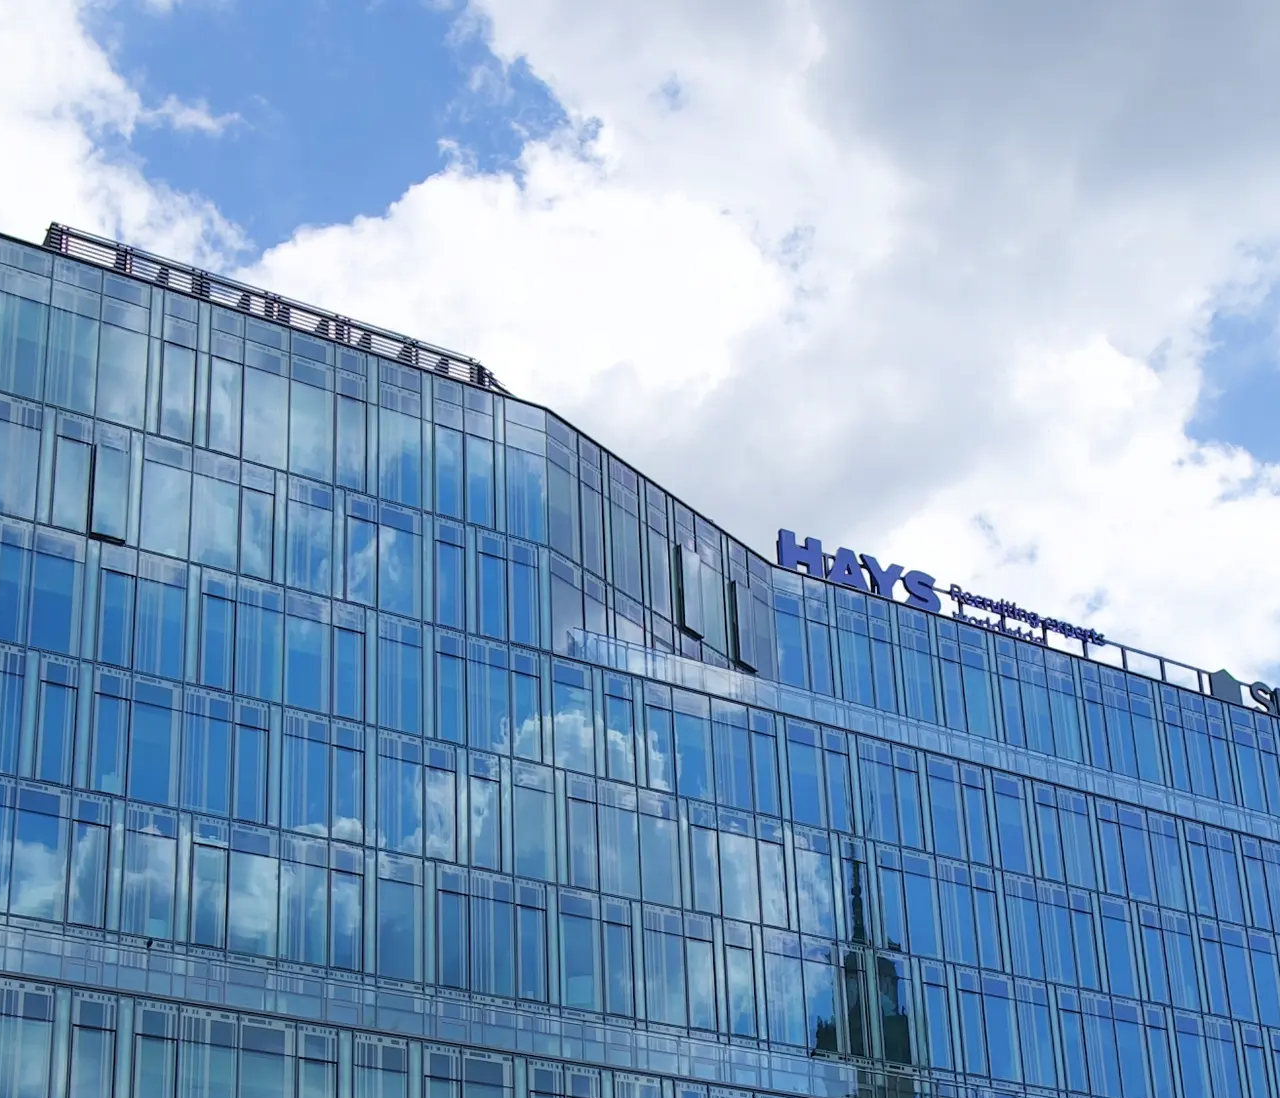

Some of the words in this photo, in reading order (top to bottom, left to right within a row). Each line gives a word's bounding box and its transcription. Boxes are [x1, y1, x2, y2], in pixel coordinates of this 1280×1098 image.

[777, 528, 941, 613] HAYS
[949, 583, 1040, 629] Recruiting
[1045, 616, 1106, 647] experts
